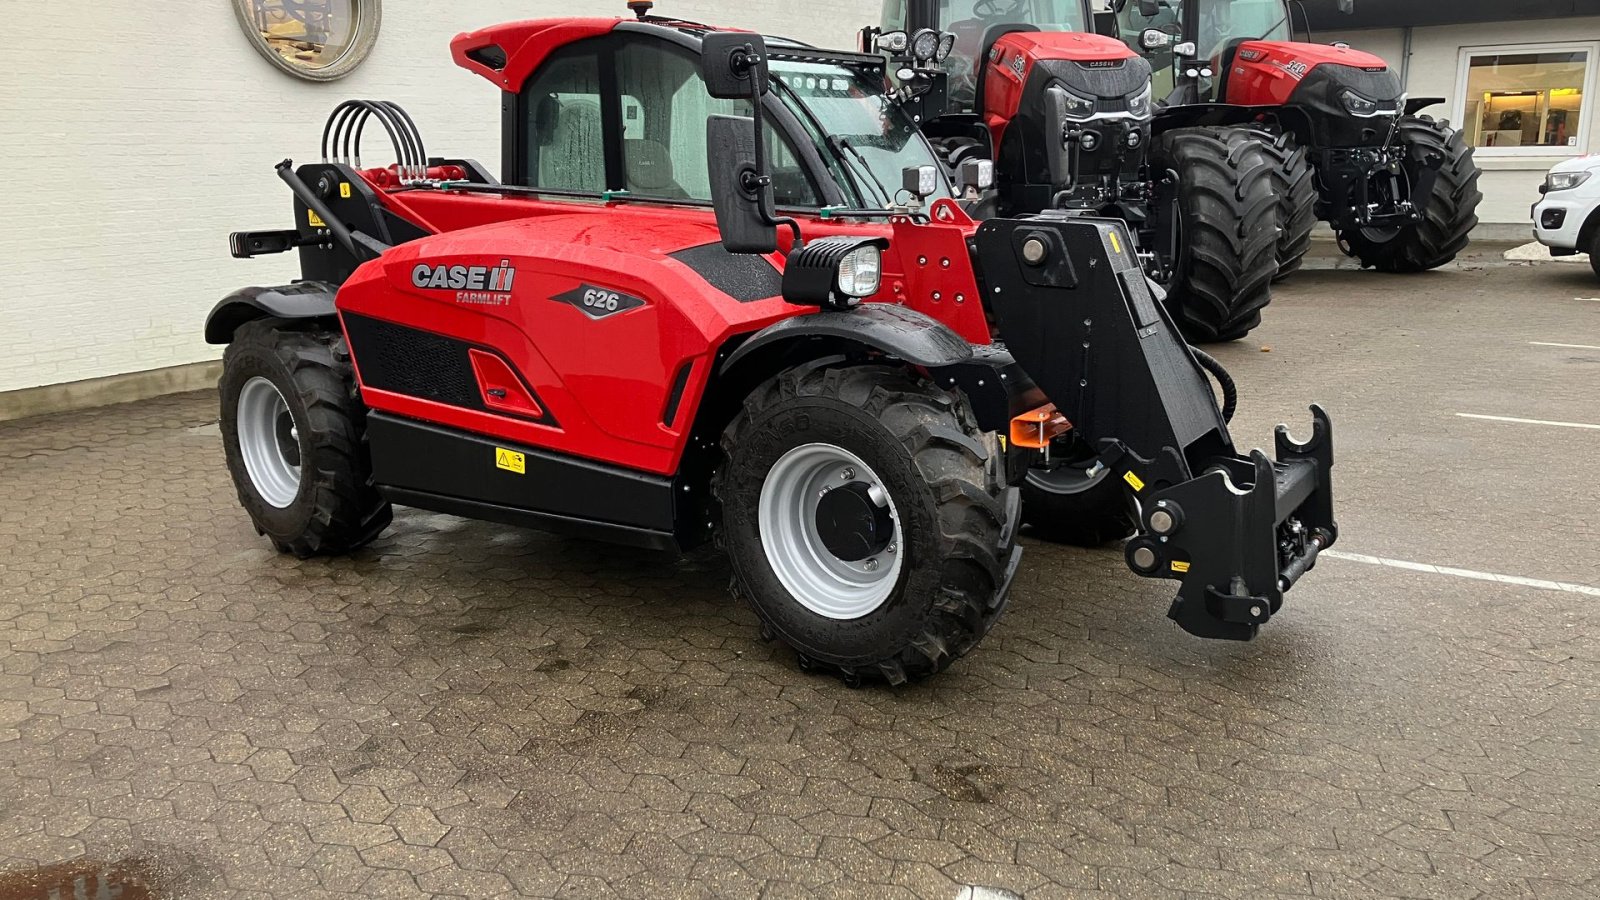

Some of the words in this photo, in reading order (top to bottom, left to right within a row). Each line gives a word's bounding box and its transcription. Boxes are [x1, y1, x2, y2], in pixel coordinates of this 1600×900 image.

[1286, 60, 1307, 74] 340
[411, 263, 487, 290] CASE
[455, 291, 512, 306] FARMLIFT
[583, 288, 620, 311] 626
